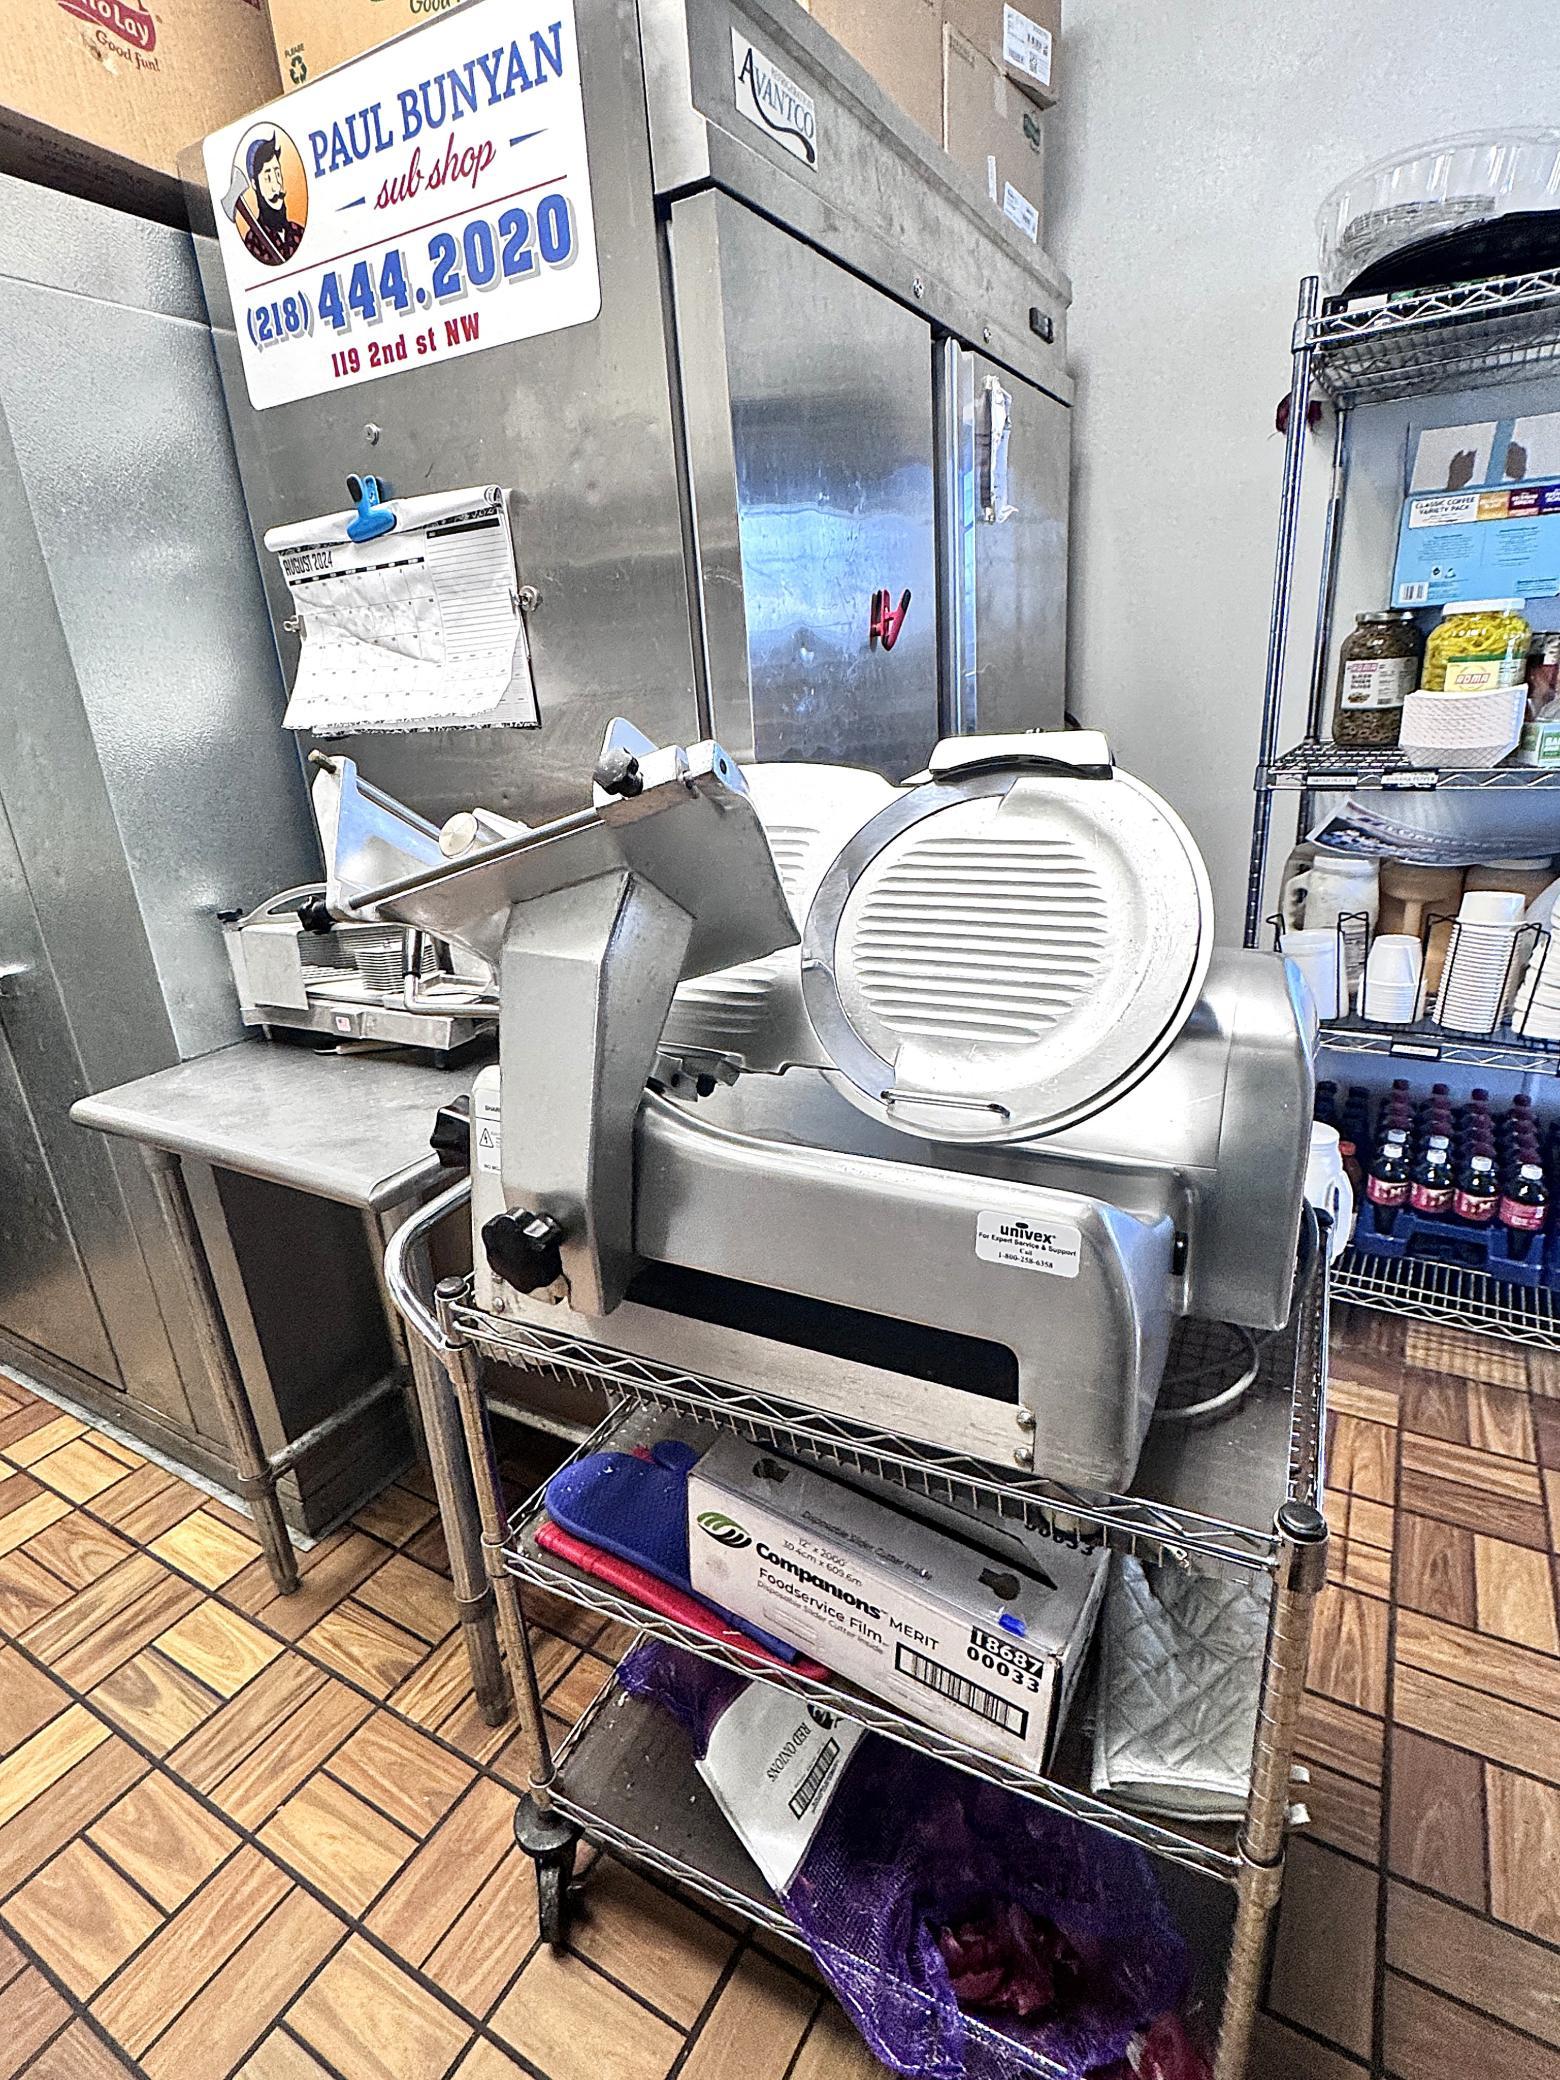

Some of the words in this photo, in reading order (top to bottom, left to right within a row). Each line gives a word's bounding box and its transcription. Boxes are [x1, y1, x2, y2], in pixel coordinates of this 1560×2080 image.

[96, 30, 132, 62] Good
[134, 52, 160, 72] fun!
[308, 103, 394, 178] PAUL
[397, 21, 563, 142] BUNYAN
[738, 47, 815, 163] AVANTCO
[374, 147, 424, 210] sub
[425, 132, 496, 190] shop
[247, 290, 311, 348] (218)
[318, 193, 575, 332] 444.2020
[331, 352, 360, 378] 119
[369, 334, 407, 368] 2nd
[416, 328, 436, 355] st
[445, 312, 480, 346] NW
[283, 553, 312, 577] AUGUST
[312, 550, 333, 570] 2024
[1456, 673, 1490, 684] ROMA
[991, 1234, 1012, 1243] Expert
[1014, 1239, 1039, 1249] Service
[1041, 1243, 1046, 1251] &
[1048, 1246, 1076, 1256] Support
[1000, 1222, 1053, 1244] univex
[1019, 1248, 1033, 1256] Call
[760, 1567, 845, 1623] Foodservice
[850, 1616, 883, 1643] Film
[889, 1616, 939, 1650] MERIT
[974, 1628, 1043, 1675] 18687
[966, 1645, 1040, 1694] 00033
[793, 1722, 811, 1746] RED
[766, 1741, 797, 1782] ONIONS
